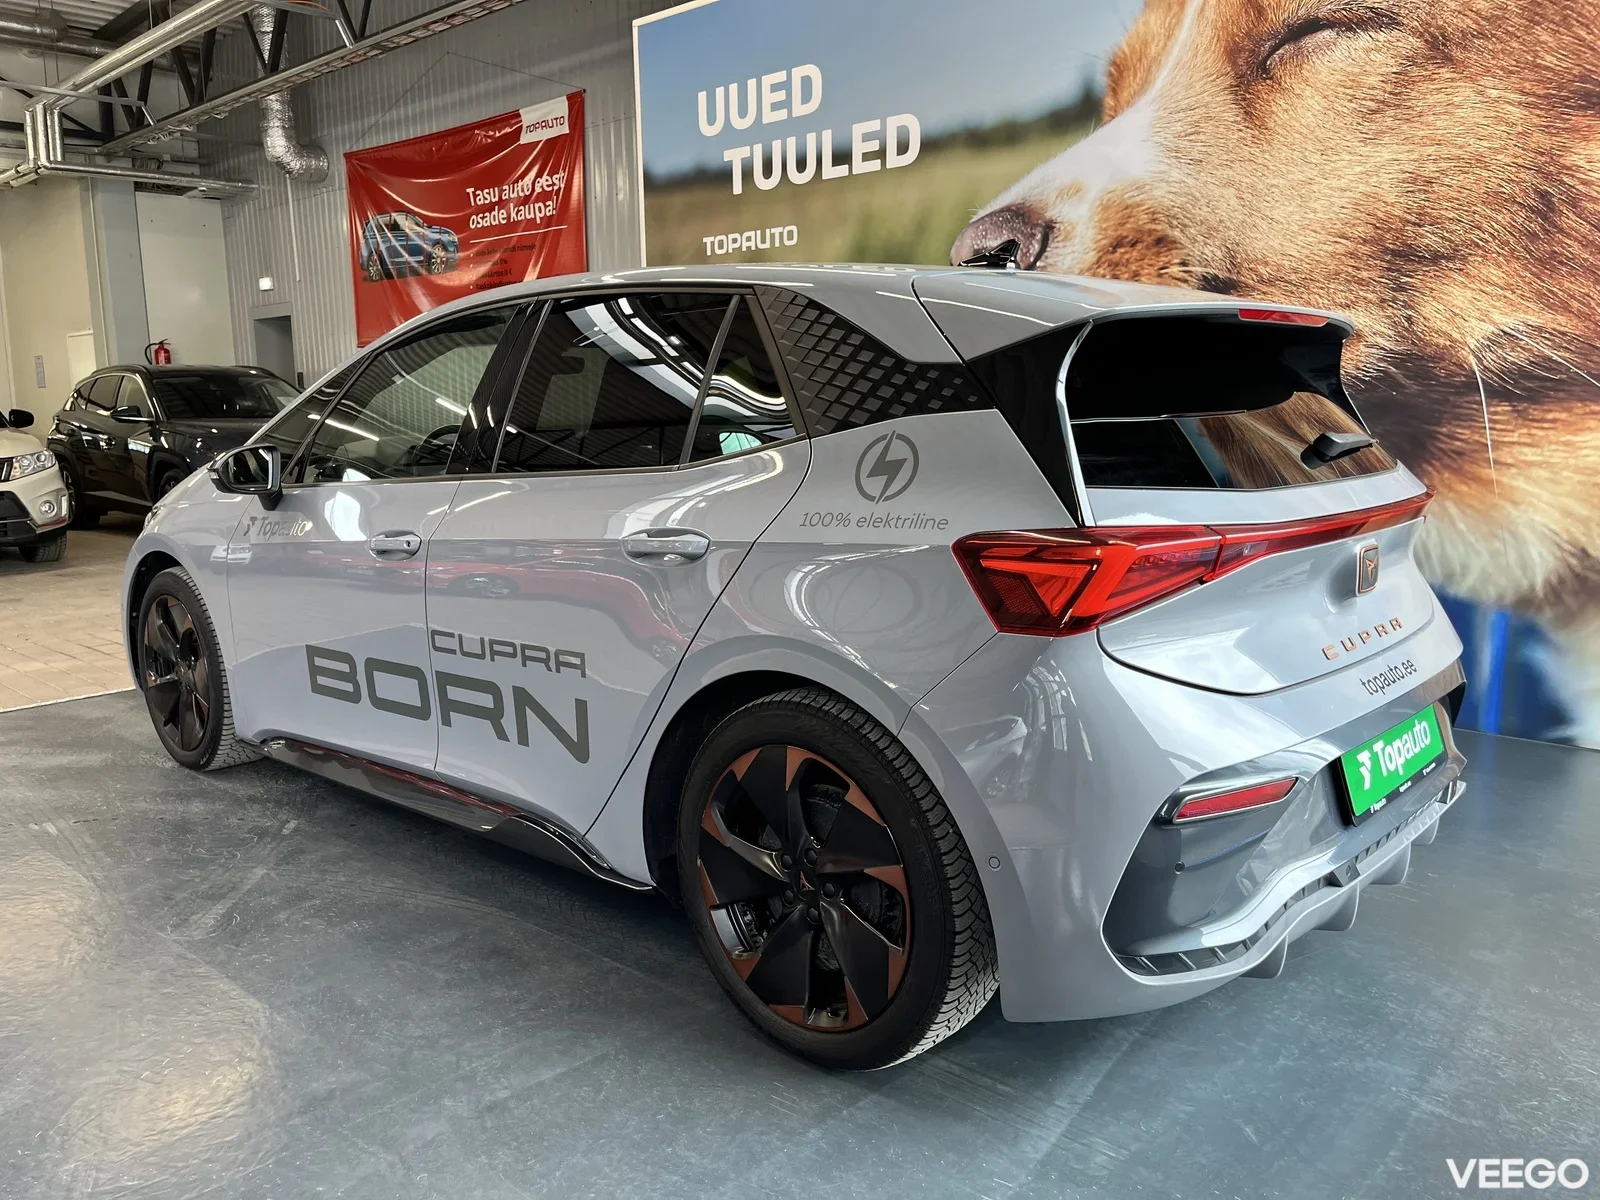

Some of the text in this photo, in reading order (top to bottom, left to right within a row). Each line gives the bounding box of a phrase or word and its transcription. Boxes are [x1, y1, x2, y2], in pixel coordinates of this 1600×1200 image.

[697, 63, 823, 137] UUED
[525, 115, 565, 135] TOPAUTO
[723, 113, 921, 196] TUULED
[466, 170, 565, 207] Tasu auto eest
[469, 195, 556, 229] osade kaupa!
[702, 225, 798, 256] TOPAUTO
[799, 511, 949, 531] 100% elektriline
[430, 629, 587, 679] CUPRA
[1322, 616, 1404, 661] CUPRA
[1360, 658, 1418, 696] topauto.ee
[305, 643, 590, 765] BORN
[1372, 718, 1431, 778] Topauto
